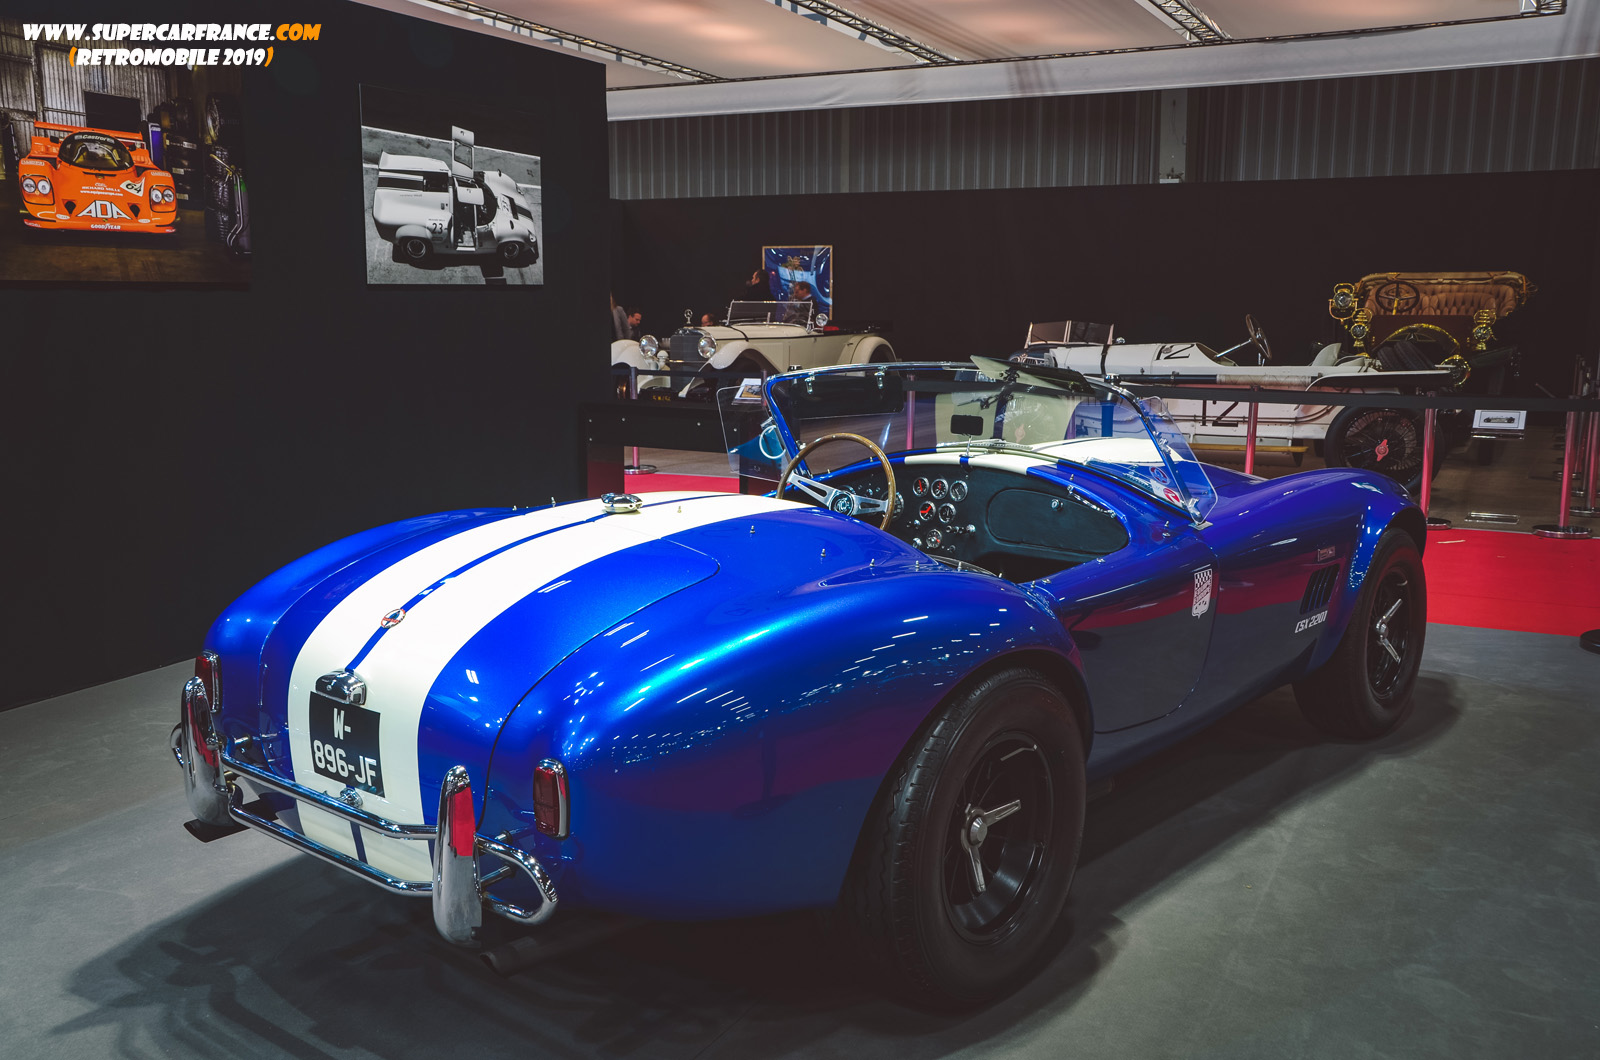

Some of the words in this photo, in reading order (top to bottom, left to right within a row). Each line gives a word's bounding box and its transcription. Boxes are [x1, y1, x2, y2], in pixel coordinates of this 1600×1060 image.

[125, 182, 143, 194] 64
[76, 200, 133, 220] ADA
[432, 222, 444, 234] 23
[1294, 617, 1311, 634] CSX
[1308, 610, 1328, 628] 2201
[333, 707, 352, 740] W-
[313, 740, 377, 786] 896-JF
